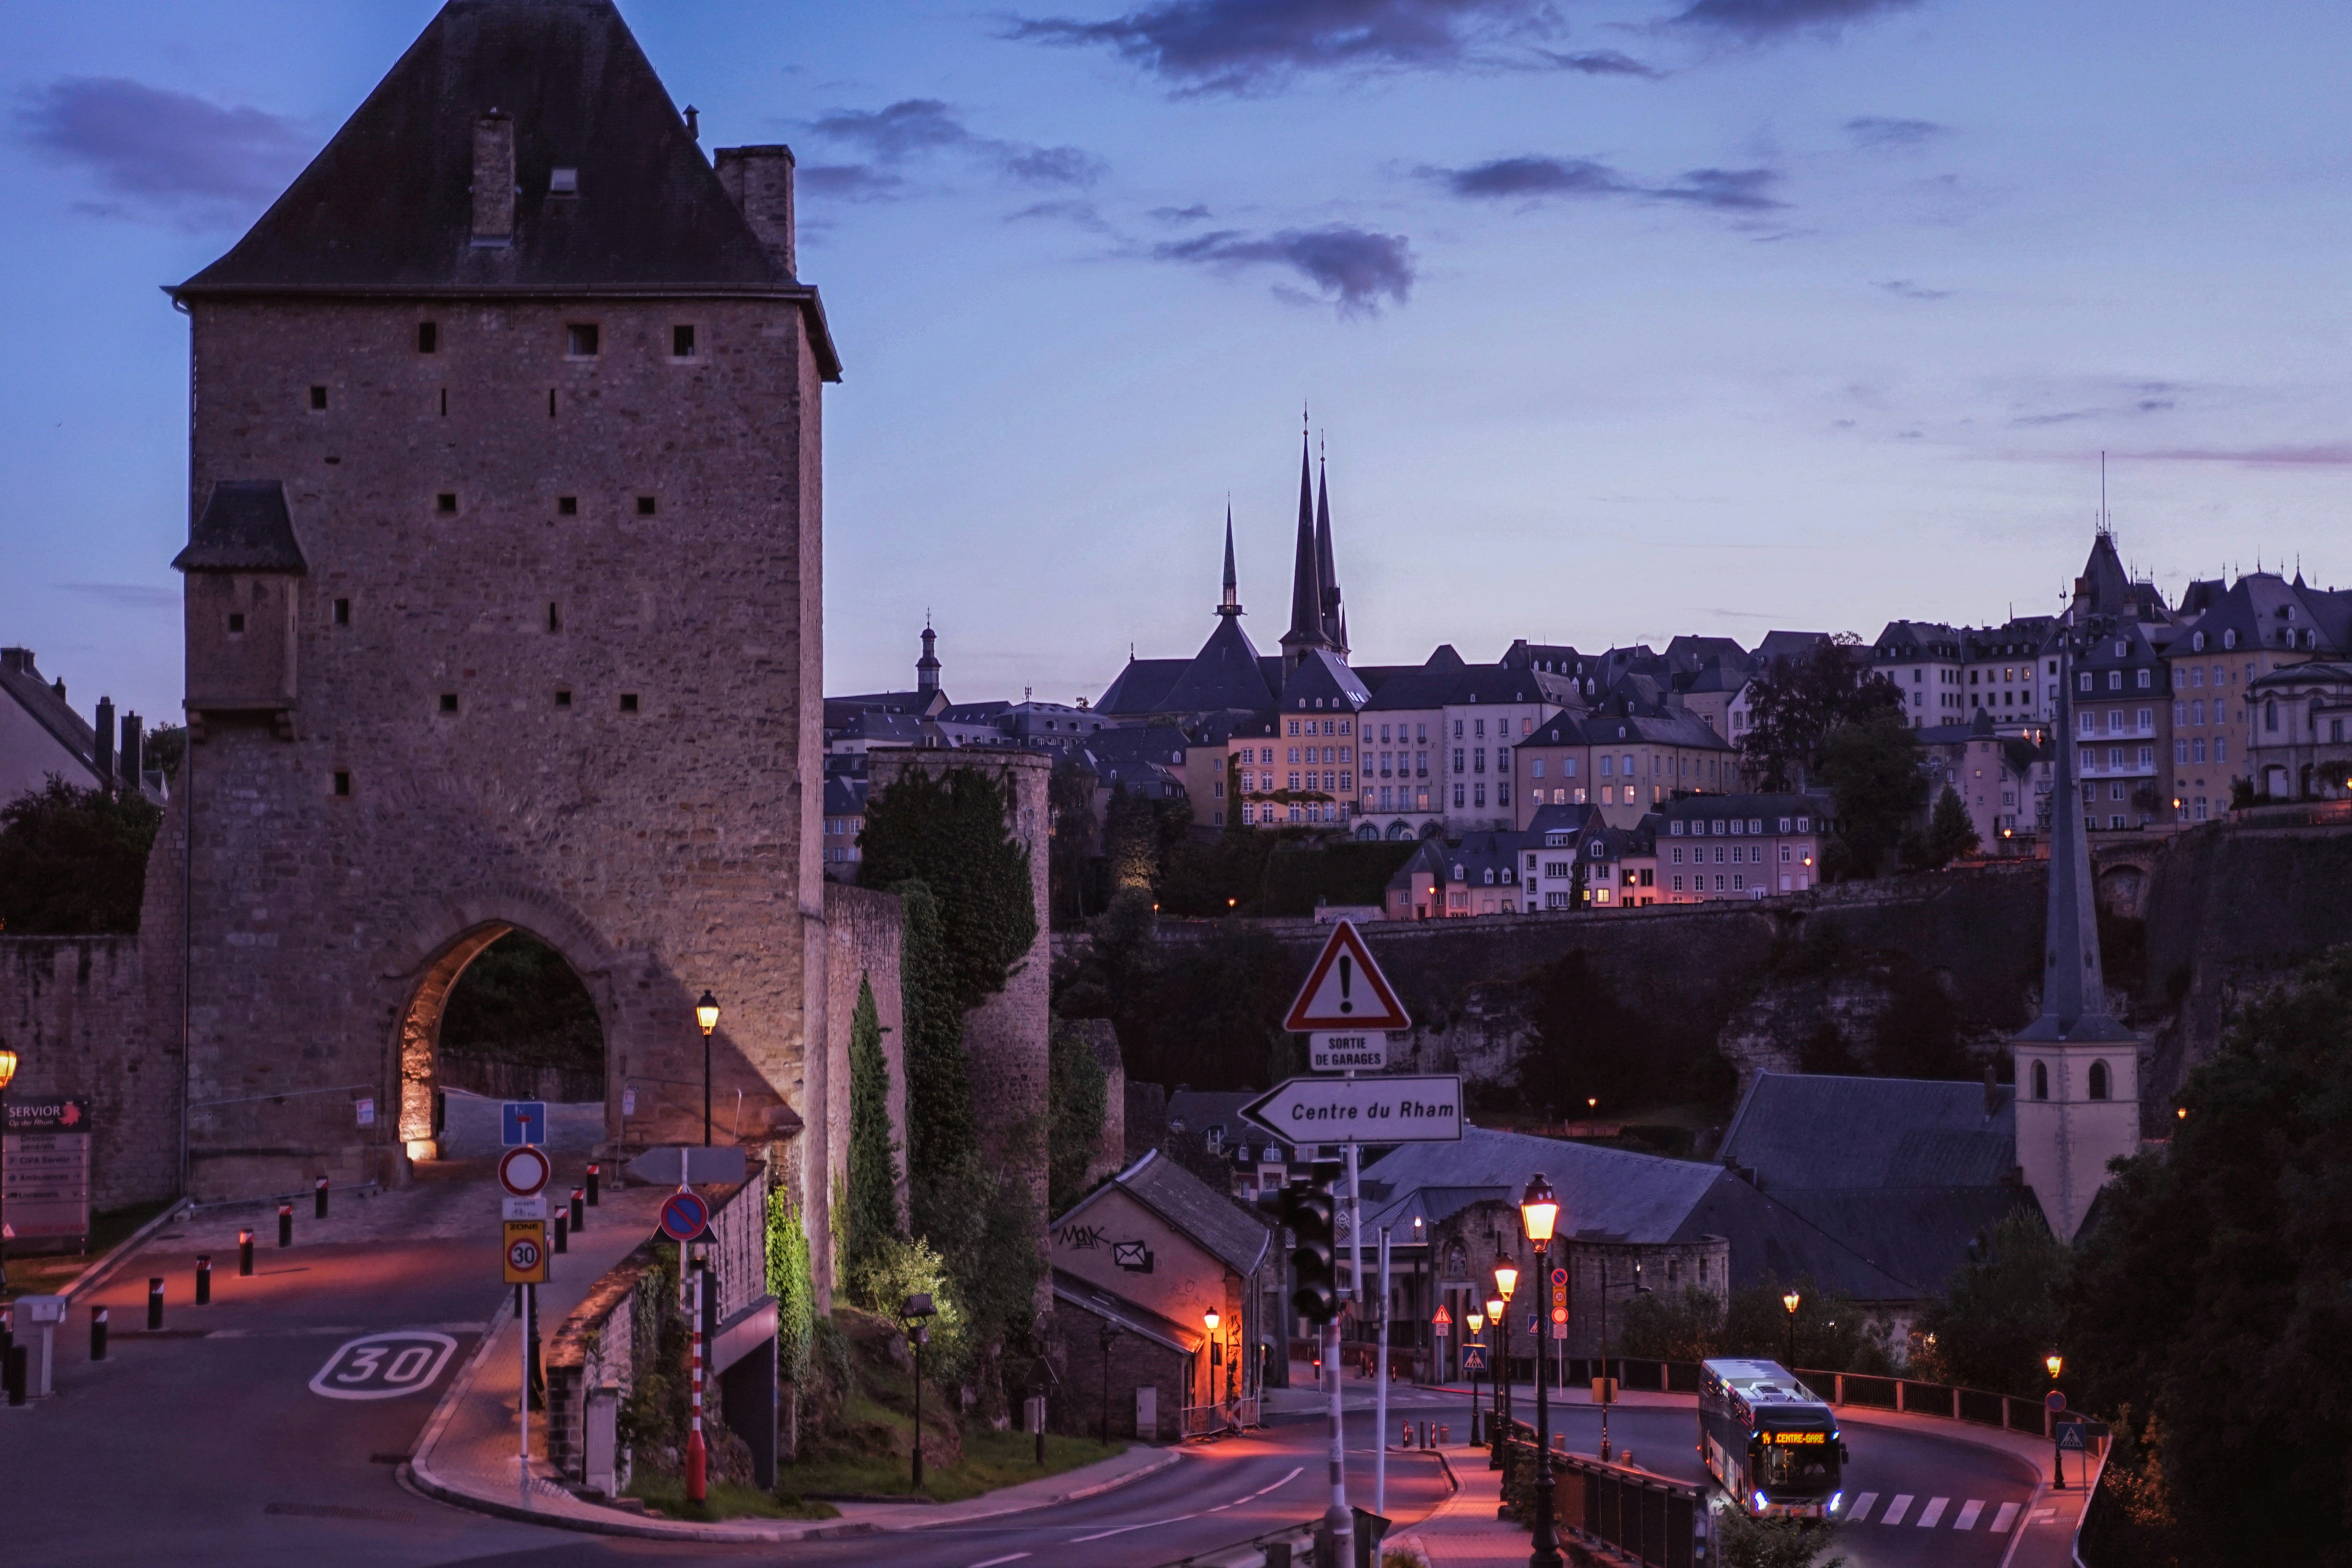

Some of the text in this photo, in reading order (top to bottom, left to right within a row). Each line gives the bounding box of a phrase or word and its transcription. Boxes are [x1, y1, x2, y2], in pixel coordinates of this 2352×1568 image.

[1328, 1037, 1367, 1049] SORTIE
[1315, 1053, 1381, 1066] DE GARAGES
[9, 1105, 60, 1117] SERVIOR
[1292, 1101, 1454, 1120] Centre du Rham
[514, 1246, 535, 1264] 30
[337, 1348, 433, 1383] 30
[1762, 1432, 1825, 1444] 14 CENTRE-GARE
